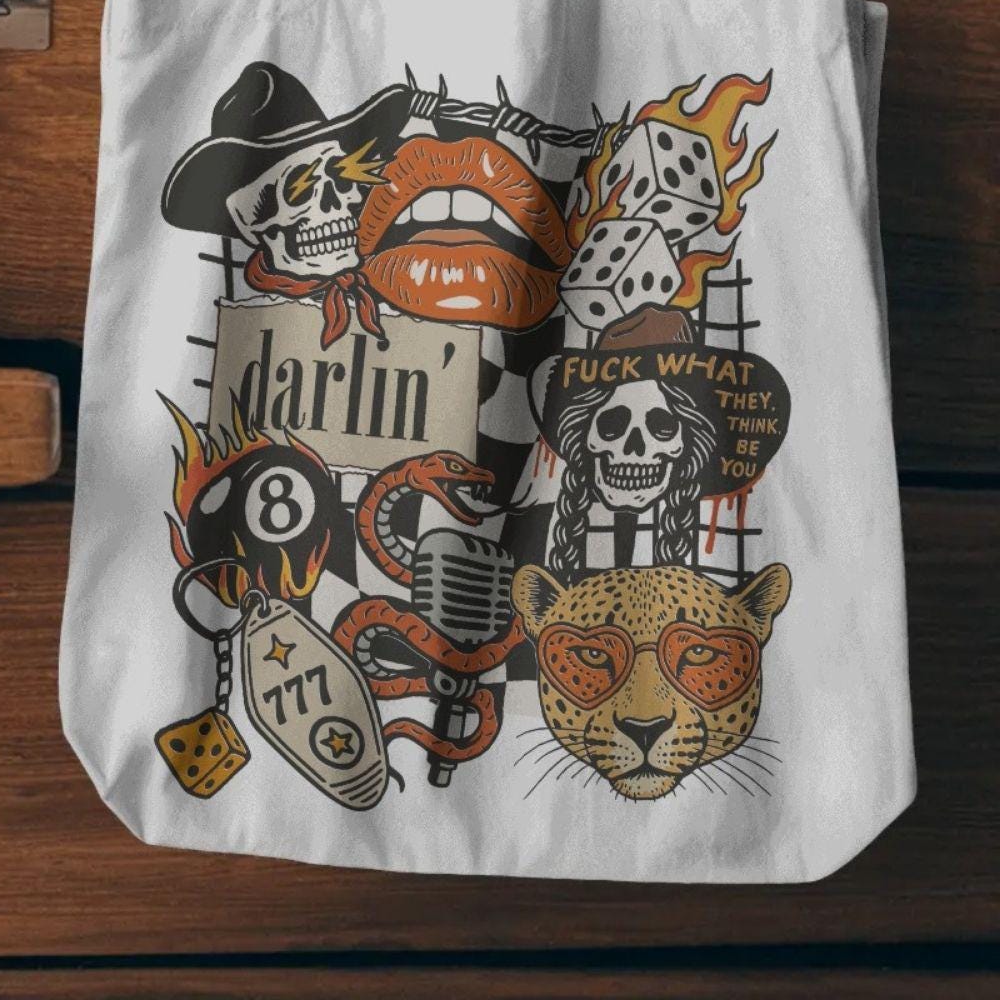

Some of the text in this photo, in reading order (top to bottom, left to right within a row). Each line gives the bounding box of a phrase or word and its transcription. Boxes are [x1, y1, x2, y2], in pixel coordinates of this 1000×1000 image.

[240, 328, 455, 442] darlin'
[563, 352, 755, 389] FUCK WHAT
[720, 457, 757, 478] YOU
[735, 439, 760, 456] BE
[258, 473, 303, 534] 8
[262, 664, 333, 726] 777
